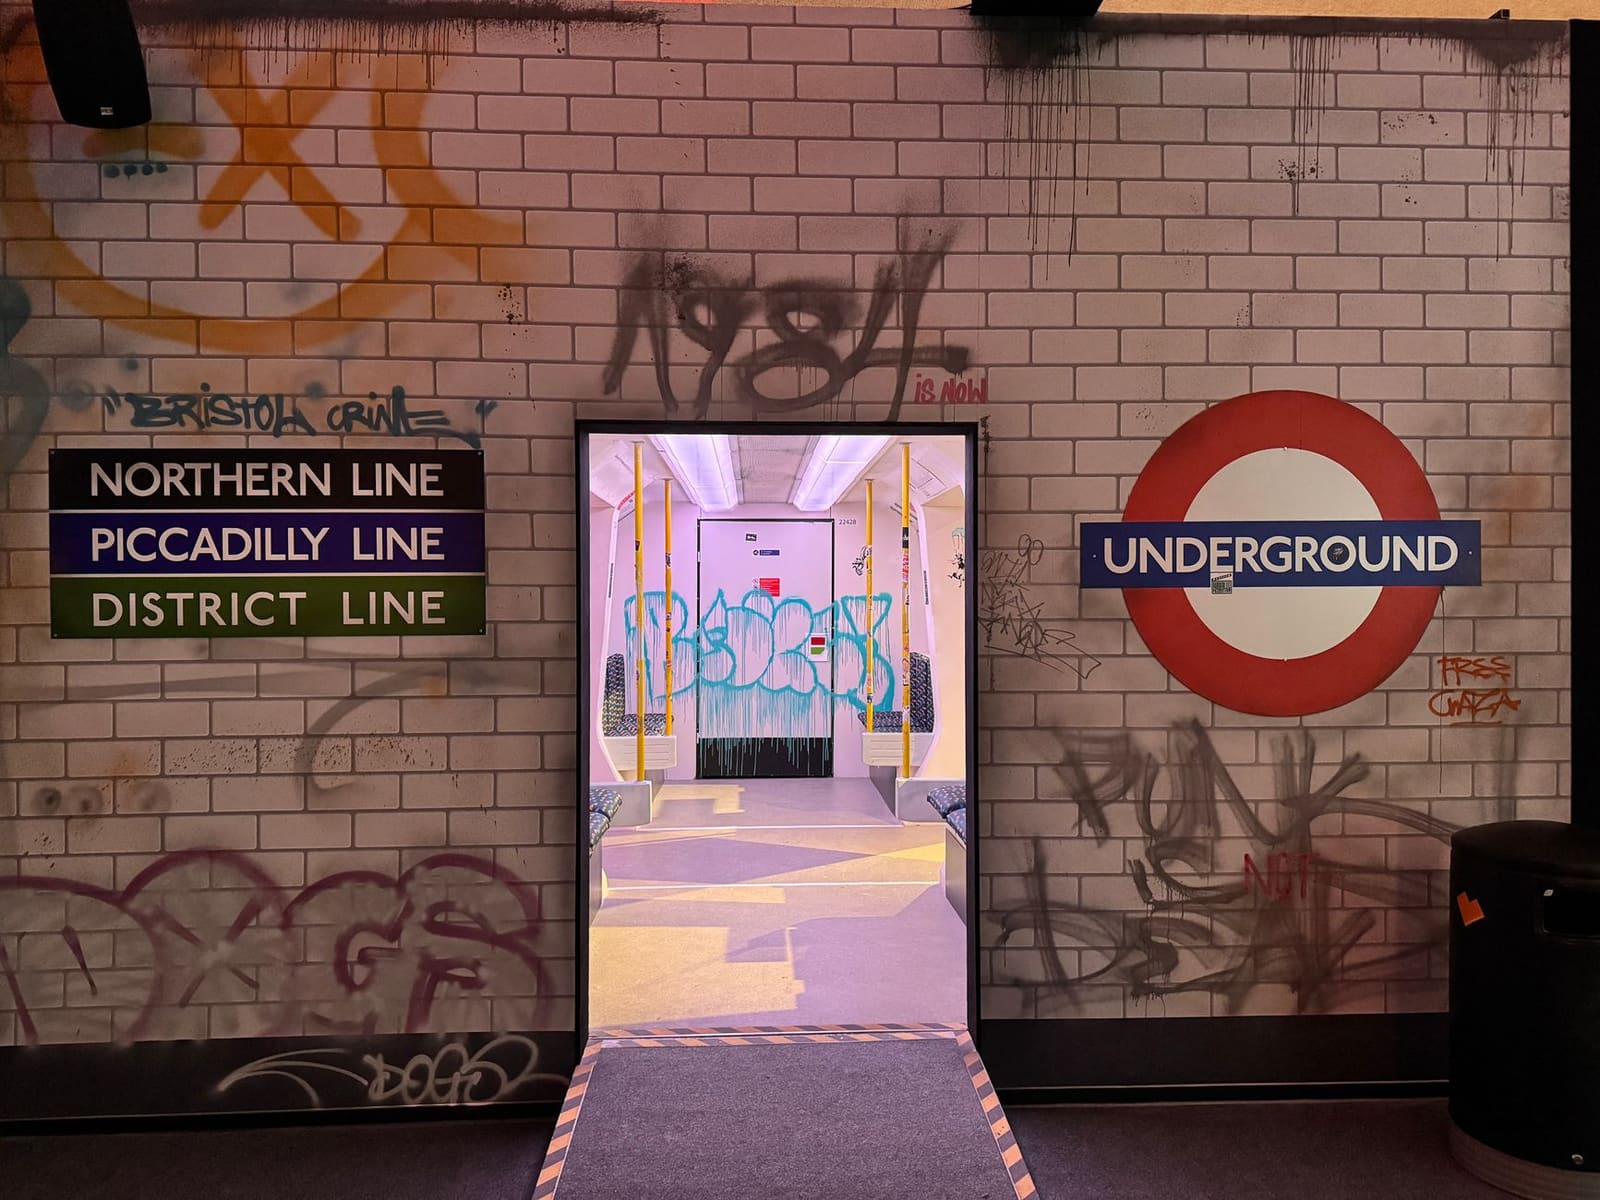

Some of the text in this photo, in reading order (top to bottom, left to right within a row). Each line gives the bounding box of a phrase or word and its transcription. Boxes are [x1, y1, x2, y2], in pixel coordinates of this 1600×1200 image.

[941, 378, 986, 404] NOW
[90, 462, 444, 498] NORTHERN LINE
[91, 527, 445, 562] PICCADILLY LINE
[1103, 535, 1459, 575] UNDERGROUND
[92, 590, 446, 627] DISTRICT LINE
[1243, 852, 1317, 901] NOT
